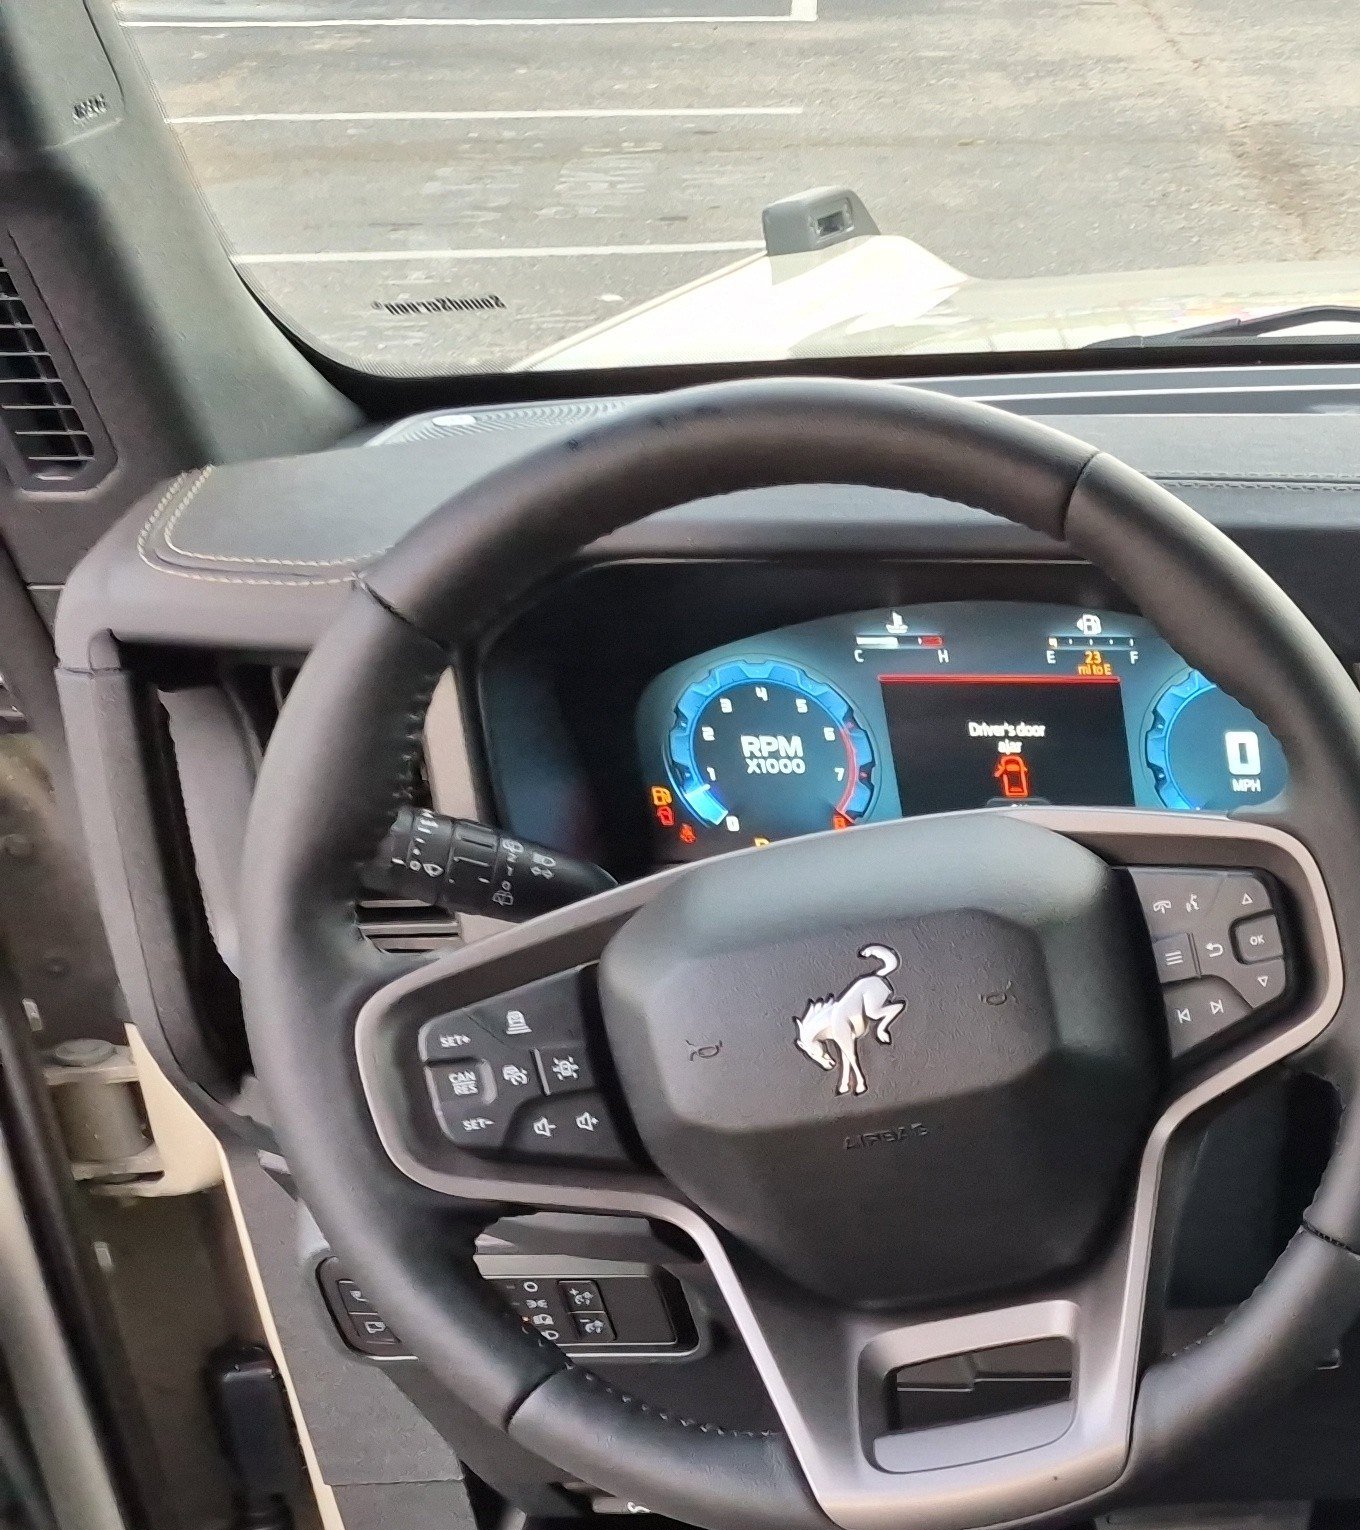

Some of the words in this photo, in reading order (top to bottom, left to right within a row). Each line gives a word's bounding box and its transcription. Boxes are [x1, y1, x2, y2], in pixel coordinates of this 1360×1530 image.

[854, 651, 864, 663] C
[937, 650, 949, 663] H
[1047, 651, 1056, 664] E
[1085, 651, 1101, 664] 23
[1130, 650, 1139, 664] F
[756, 687, 768, 701] 4
[720, 698, 733, 713] 3
[796, 699, 808, 713] 5
[702, 727, 715, 741] 2
[824, 727, 835, 741] 6
[968, 721, 1016, 737] Driver's
[1016, 722, 1045, 737] door
[741, 735, 803, 757] RPM
[998, 741, 1022, 754] ajar
[1225, 732, 1261, 775] 0
[746, 759, 805, 774] X1000
[706, 767, 716, 781] 1
[834, 767, 844, 781] 7
[1232, 779, 1261, 792] MPH
[1250, 935, 1265, 946] OK
[449, 1071, 476, 1083] CAN
[453, 1083, 478, 1096] RES
